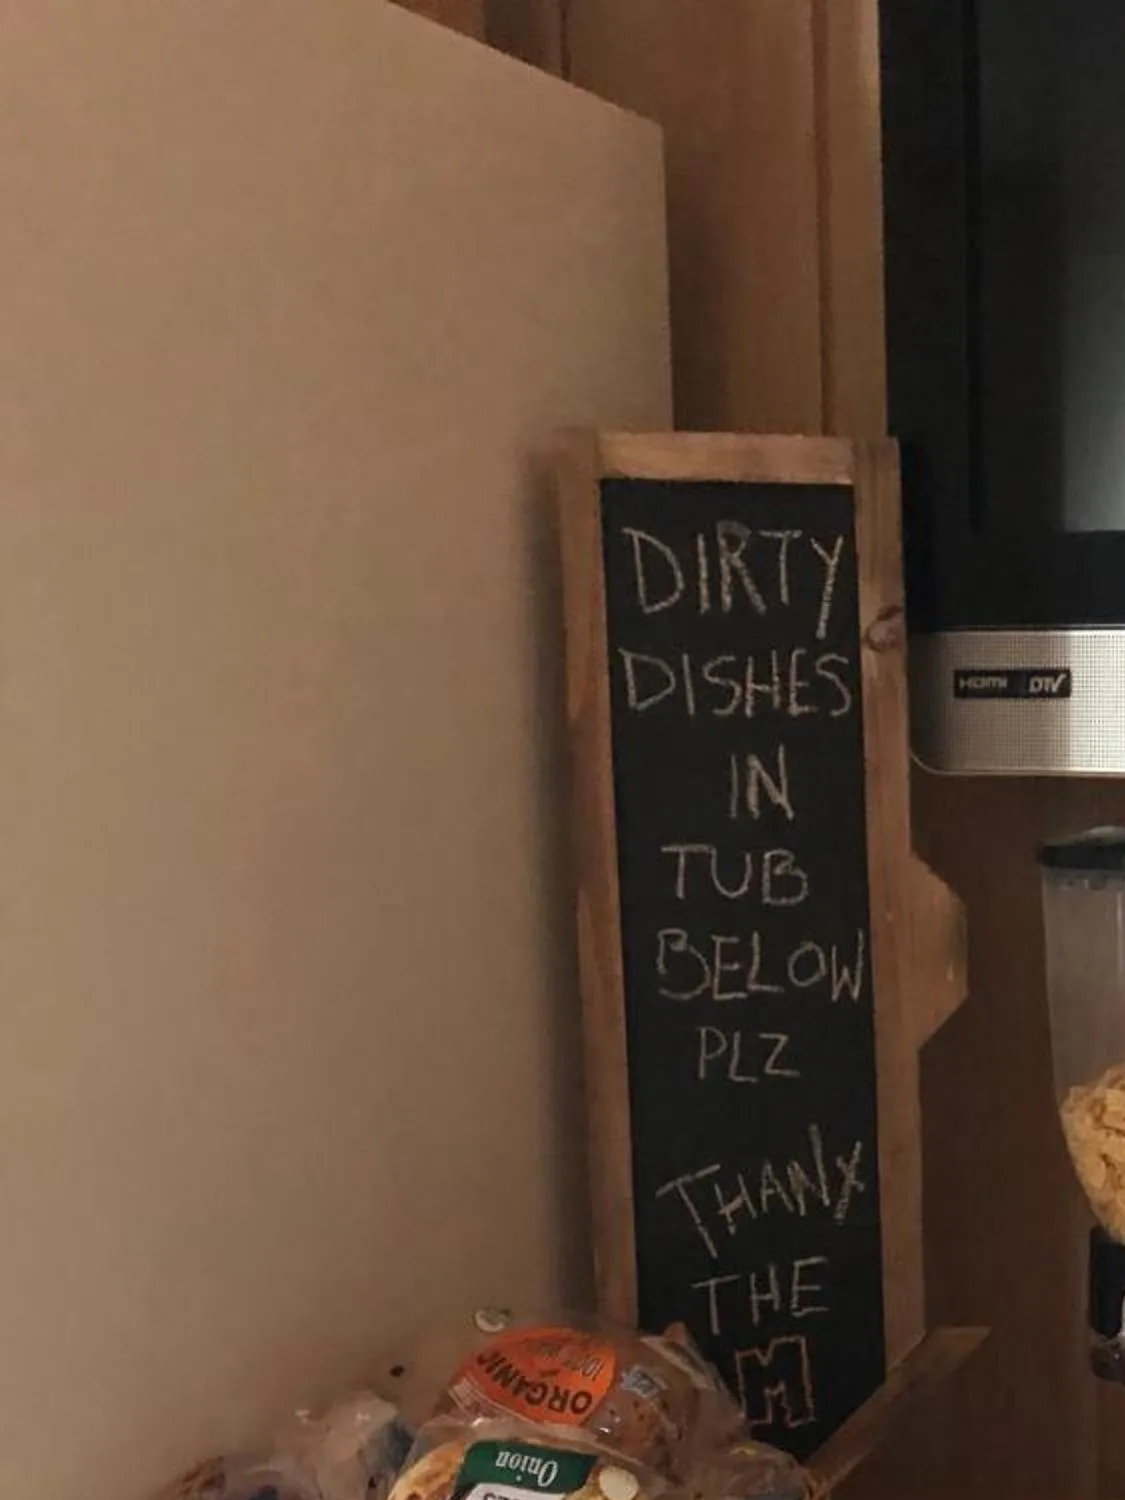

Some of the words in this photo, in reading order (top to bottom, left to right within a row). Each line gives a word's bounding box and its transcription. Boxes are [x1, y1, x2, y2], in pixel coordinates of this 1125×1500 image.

[622, 520, 844, 640] DIRTY
[617, 648, 852, 718] DISHES
[729, 743, 795, 820] IN
[660, 844, 809, 906] TUB
[656, 927, 864, 1002] BELOW
[697, 1026, 801, 1083] PLZ
[655, 1123, 865, 1258] THANX
[691, 1256, 829, 1335] THE
[476, 1352, 594, 1415] ORGANIC
[496, 1451, 559, 1488] Onion
